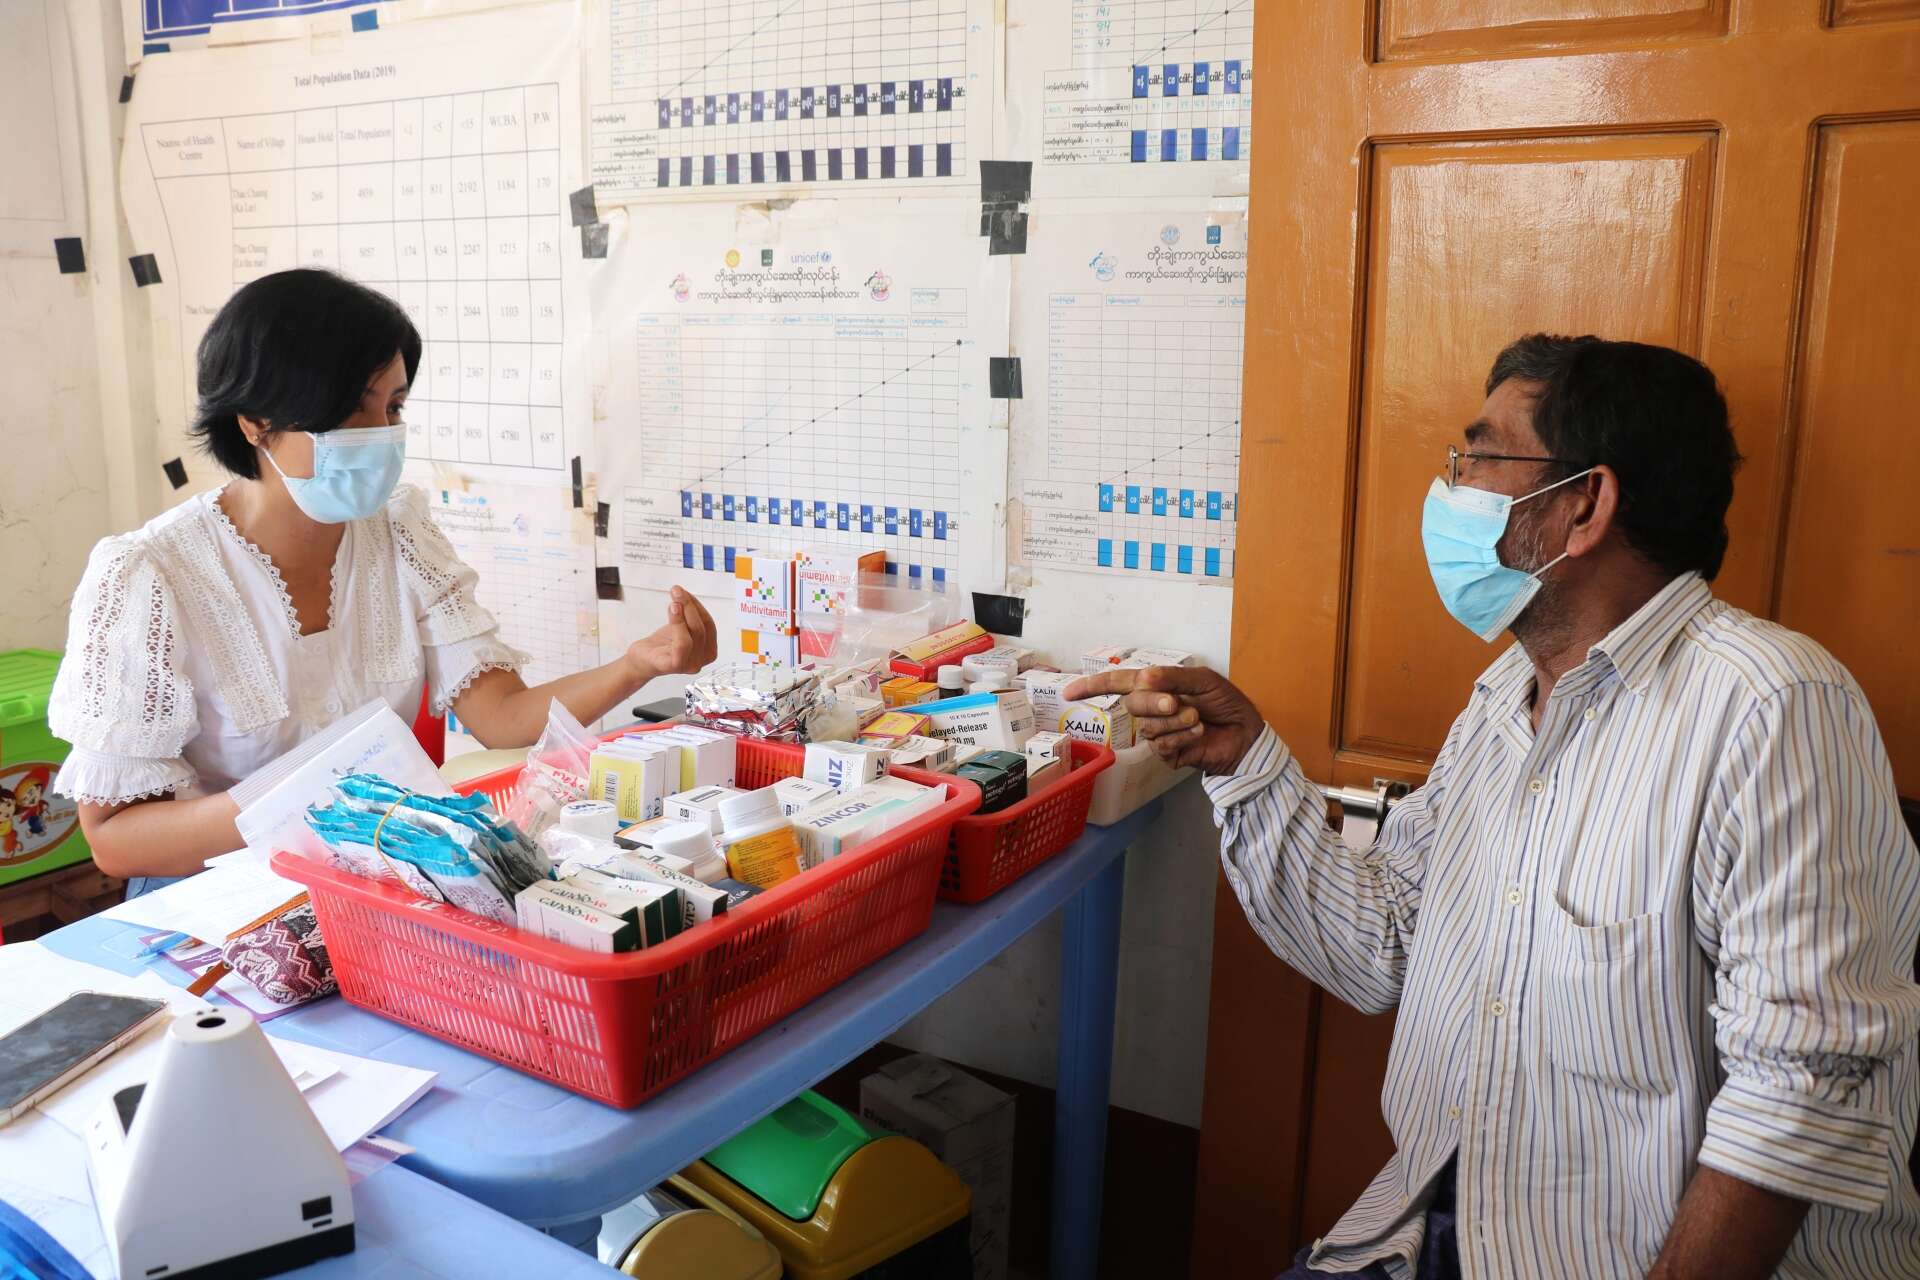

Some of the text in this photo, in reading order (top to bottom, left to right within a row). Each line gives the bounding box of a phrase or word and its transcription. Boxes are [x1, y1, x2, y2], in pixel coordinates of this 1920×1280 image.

[294, 65, 396, 87] Total Population Data (2019)
[791, 251, 820, 265] unicef
[740, 602, 787, 618] Multivitamin
[1033, 688, 1056, 696] XALIN
[930, 722, 988, 738] elayed-Release
[1065, 719, 1105, 735] XALIN
[963, 737, 975, 745] mg
[809, 802, 873, 828] ZINCOR
